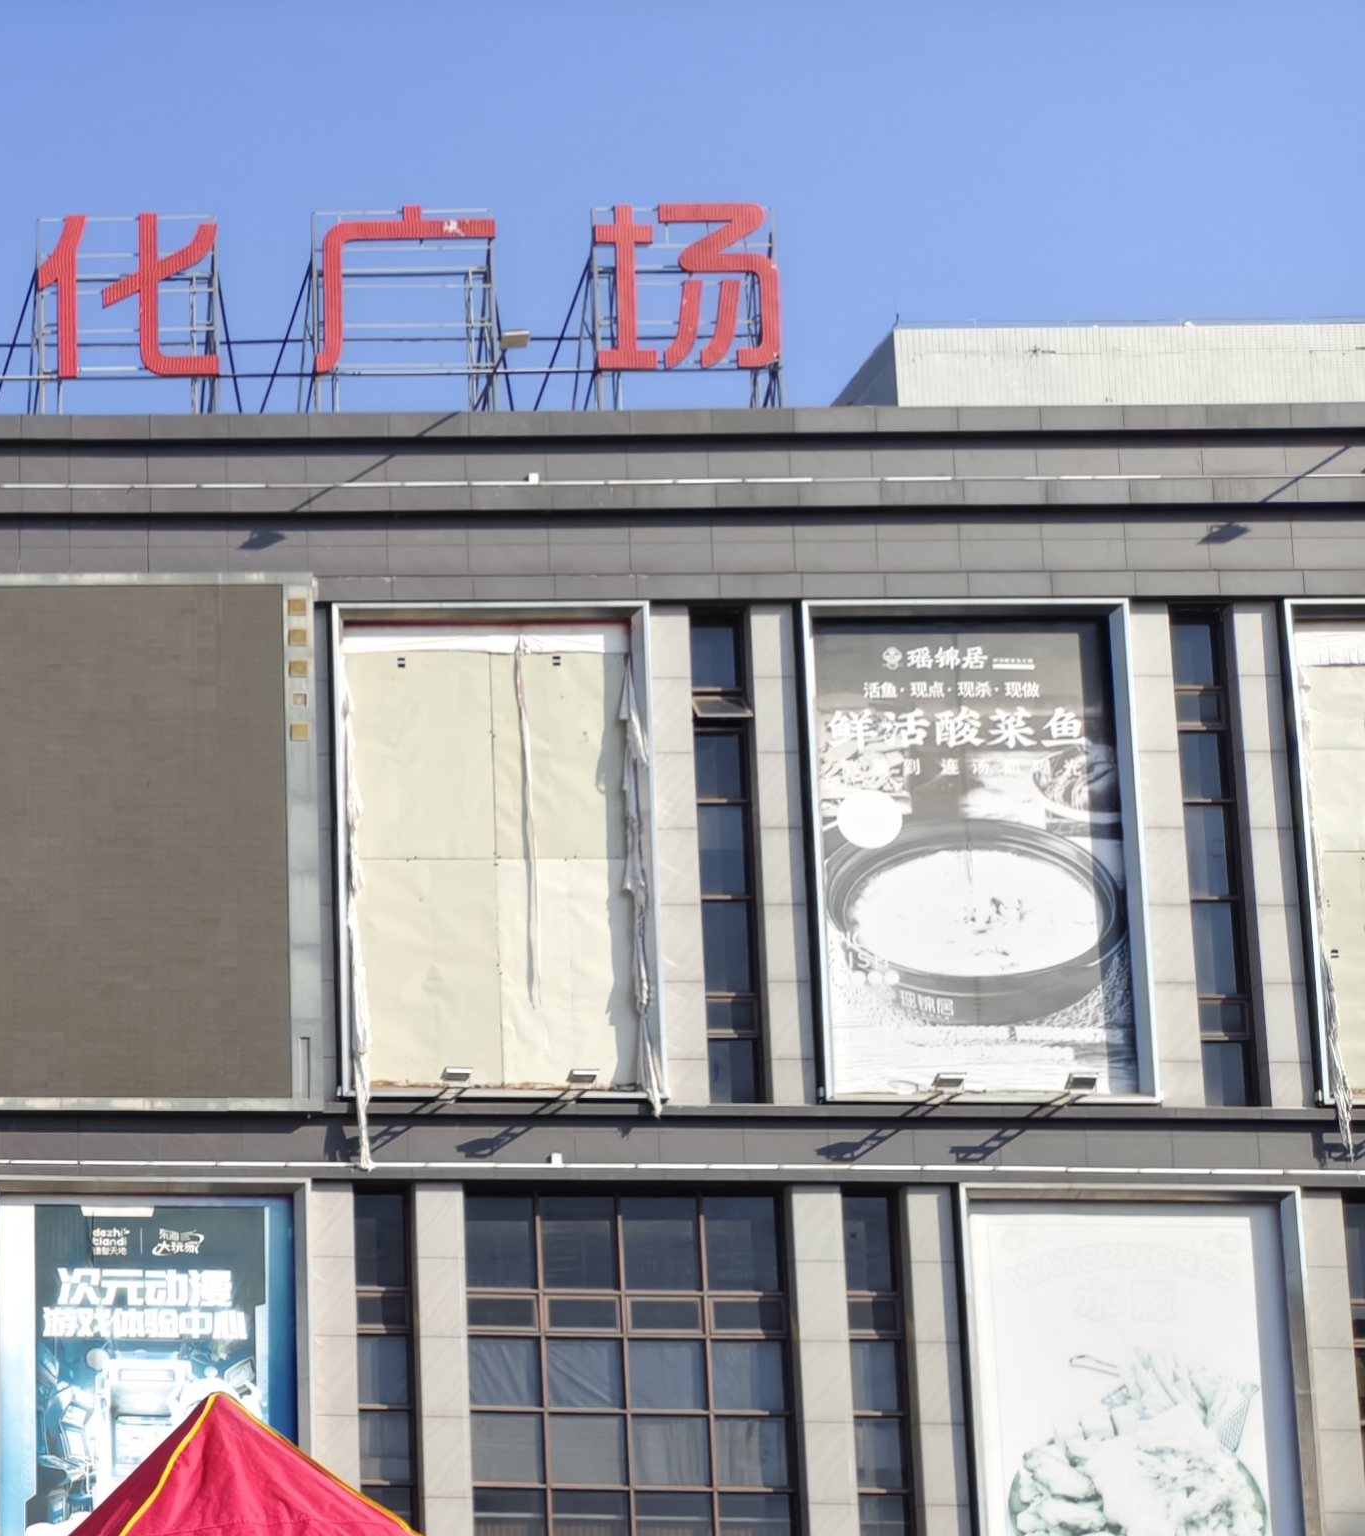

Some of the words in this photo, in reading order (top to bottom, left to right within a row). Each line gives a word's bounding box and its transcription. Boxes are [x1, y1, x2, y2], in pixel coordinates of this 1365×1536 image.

[825, 706, 1087, 750] 鲜活酸菜鱼
[56, 1267, 233, 1308] 次元动漫
[42, 1306, 248, 1340] 游戏体验中心
